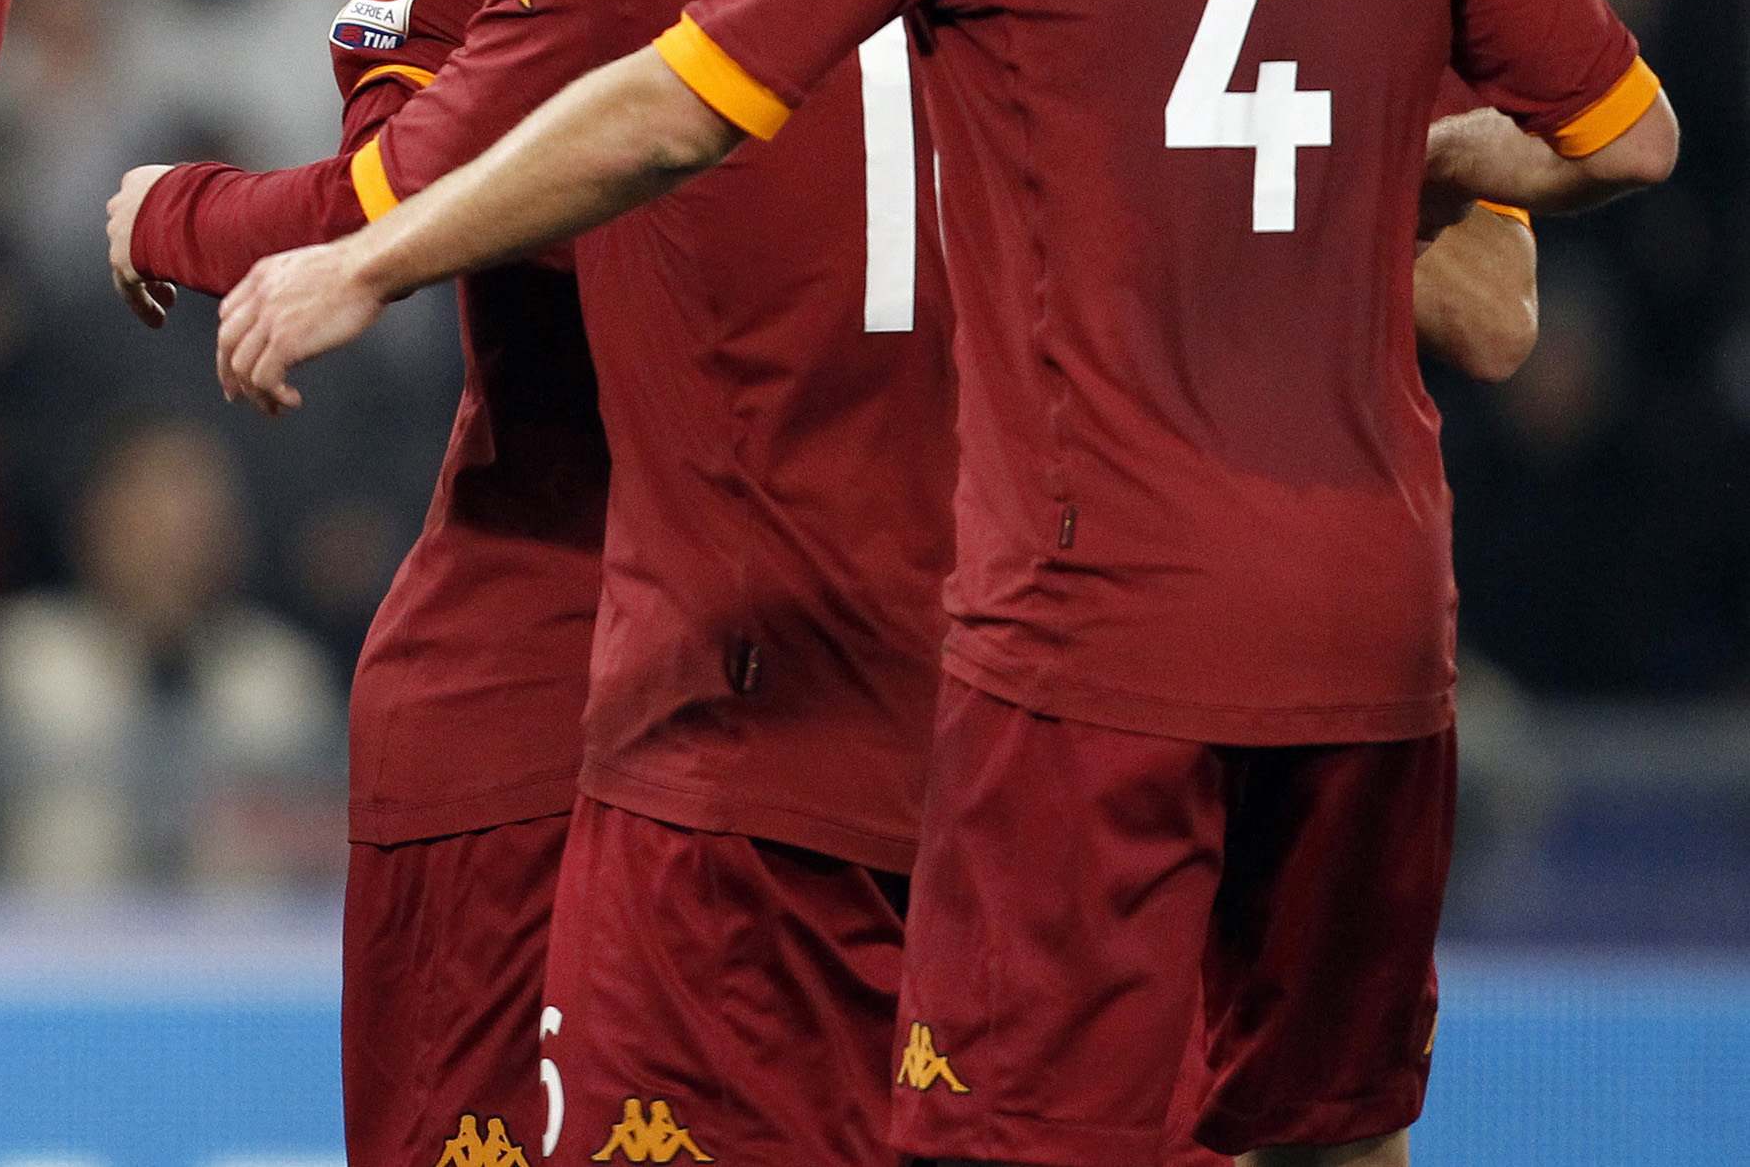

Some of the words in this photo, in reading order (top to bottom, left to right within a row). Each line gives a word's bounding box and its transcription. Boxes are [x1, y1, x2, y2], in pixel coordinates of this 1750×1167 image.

[384, 10, 394, 24] A
[364, 31, 397, 49] TIM
[858, 16, 947, 332] 1
